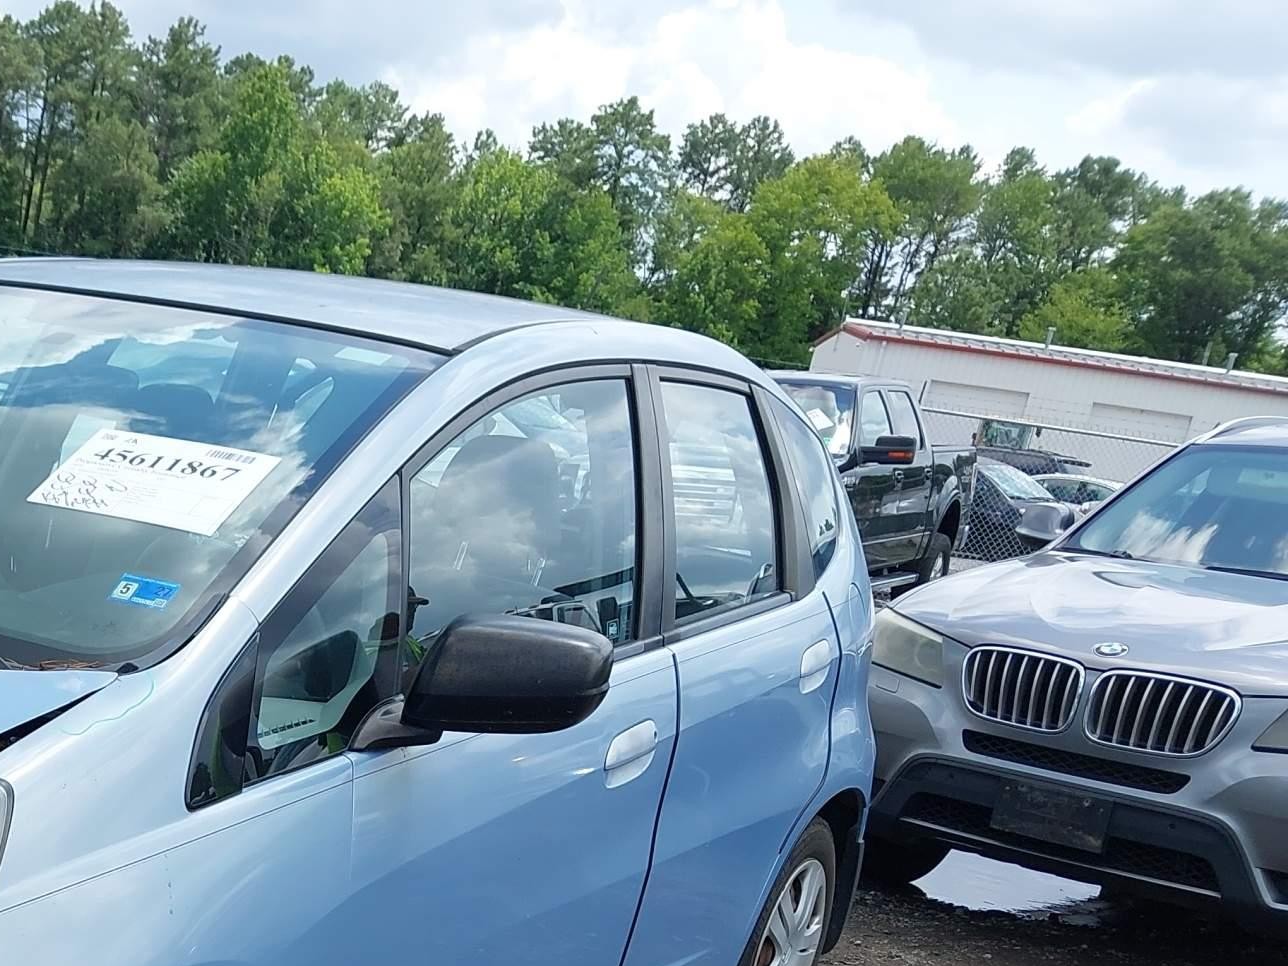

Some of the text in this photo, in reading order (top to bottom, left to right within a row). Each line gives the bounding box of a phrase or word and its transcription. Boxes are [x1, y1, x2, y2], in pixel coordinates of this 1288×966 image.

[94, 447, 242, 482] 45611867
[119, 582, 133, 595] 5
[153, 586, 173, 597] 27
